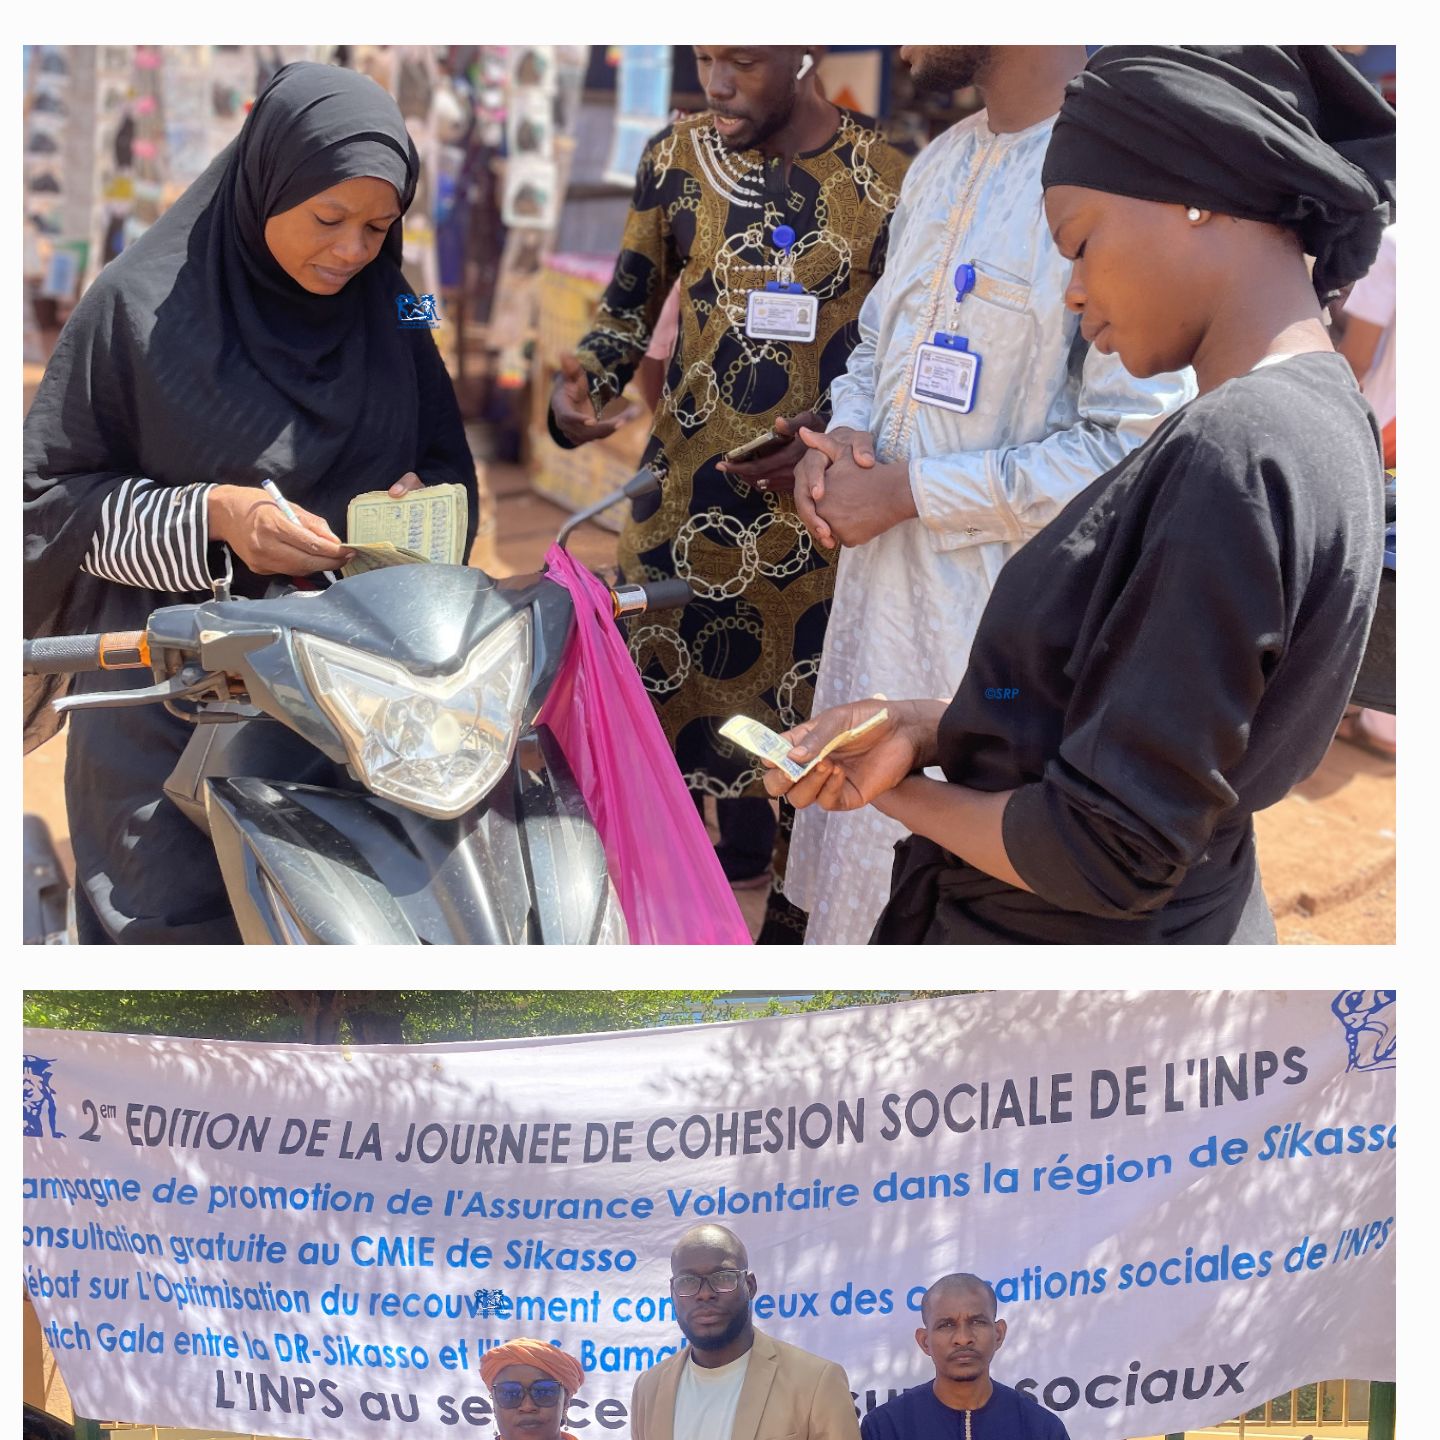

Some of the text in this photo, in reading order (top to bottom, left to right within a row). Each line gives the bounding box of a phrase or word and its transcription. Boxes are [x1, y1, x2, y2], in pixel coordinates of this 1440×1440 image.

[125, 1102, 271, 1154] EDITION
[278, 1118, 331, 1158] DE
[338, 1119, 383, 1162] LA
[395, 1122, 572, 1165] JOURNEE
[582, 1120, 634, 1164] DE
[646, 1098, 865, 1162] COHESION
[879, 1072, 1073, 1142] SOCIALE
[1090, 1065, 1147, 1120] DE
[1164, 1046, 1309, 1113] L'INPS
[23, 1176, 142, 1207] ampagne
[151, 1177, 198, 1206] de
[207, 1182, 375, 1214] promotion
[386, 1188, 433, 1216] de
[444, 1189, 654, 1220] l'Assurance
[666, 1178, 860, 1218] Volontaire
[872, 1172, 970, 1203] dans
[983, 1162, 1020, 1194] la
[1033, 1153, 1172, 1196] région
[1188, 1135, 1249, 1168] de
[23, 1222, 638, 1272] onsultation gratuite au CMIE de Sikasso
[89, 1275, 129, 1301] sur
[136, 1271, 310, 1314] L'Optimisation
[320, 1283, 360, 1316] du
[829, 1282, 895, 1316] des
[1117, 1244, 1274, 1292] sociales
[1283, 1236, 1328, 1274] de
[44, 1320, 92, 1350] atch
[96, 1322, 165, 1355] Gala
[173, 1327, 240, 1358] entre
[245, 1330, 271, 1361] la
[274, 1332, 430, 1371] DR-Sikasso
[438, 1338, 469, 1370] et
[215, 1360, 1250, 1429] L'INPS au sece sociaux
